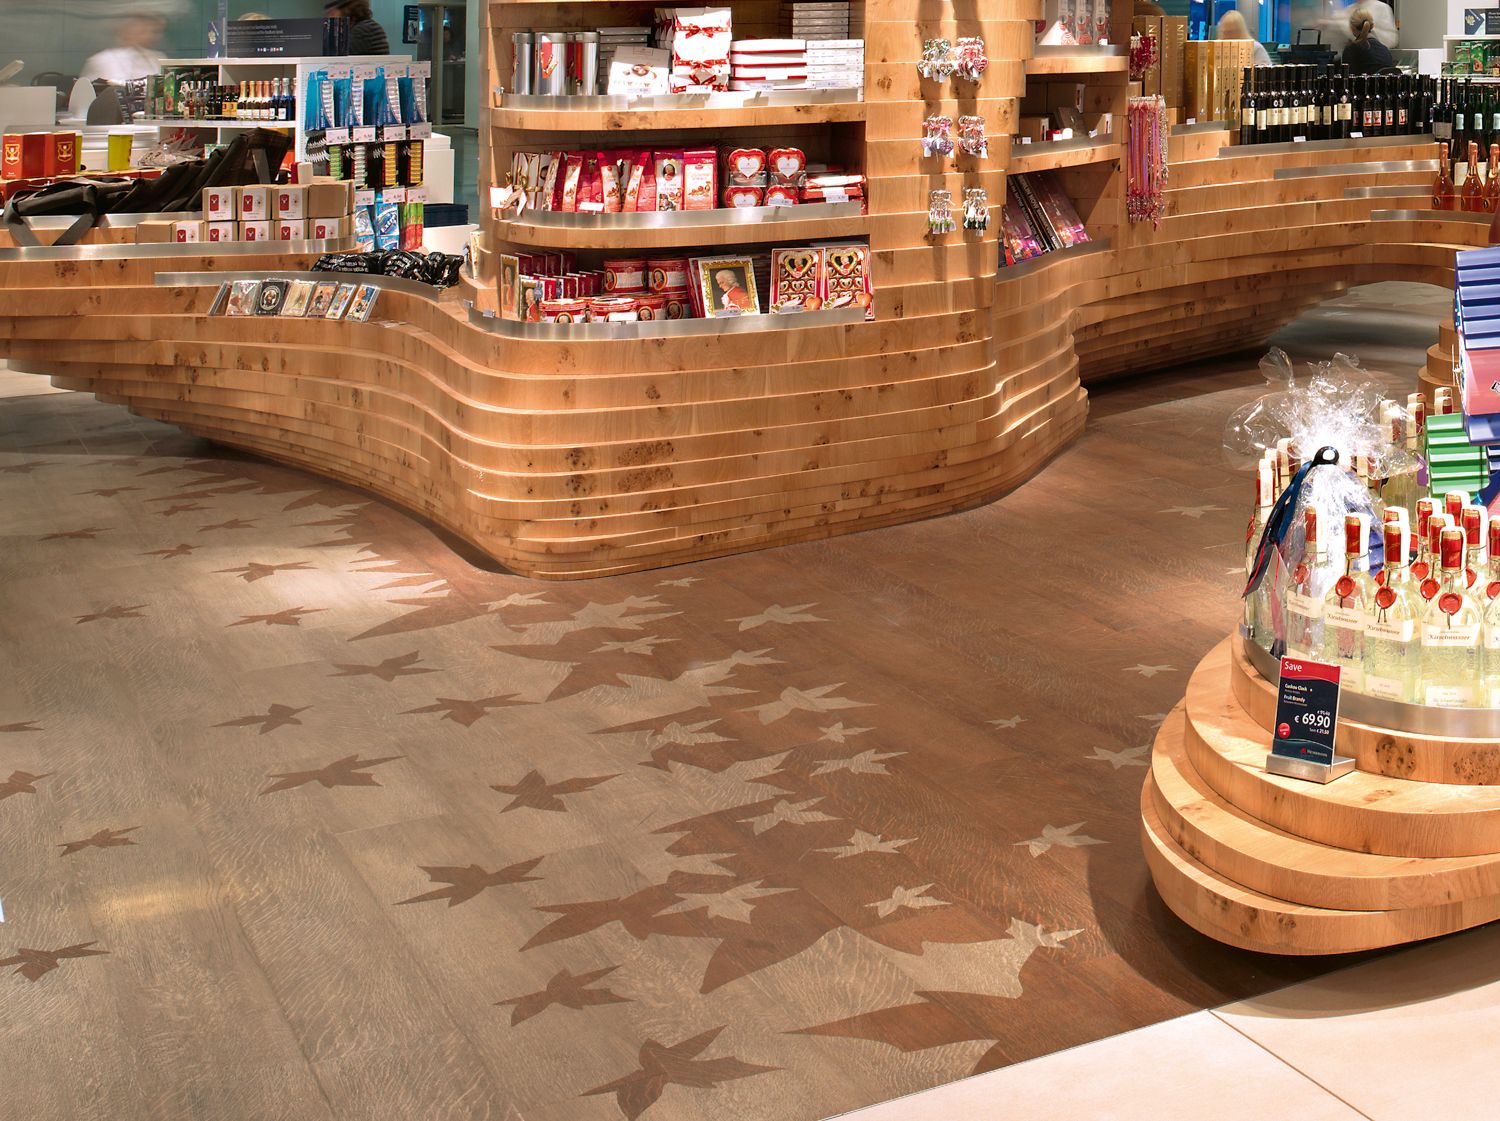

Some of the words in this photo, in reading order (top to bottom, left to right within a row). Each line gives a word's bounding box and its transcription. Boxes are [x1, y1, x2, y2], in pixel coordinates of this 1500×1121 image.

[1284, 661, 1302, 672] Save
[1294, 715, 1300, 723] €
[1302, 713, 1331, 728] 69.90
